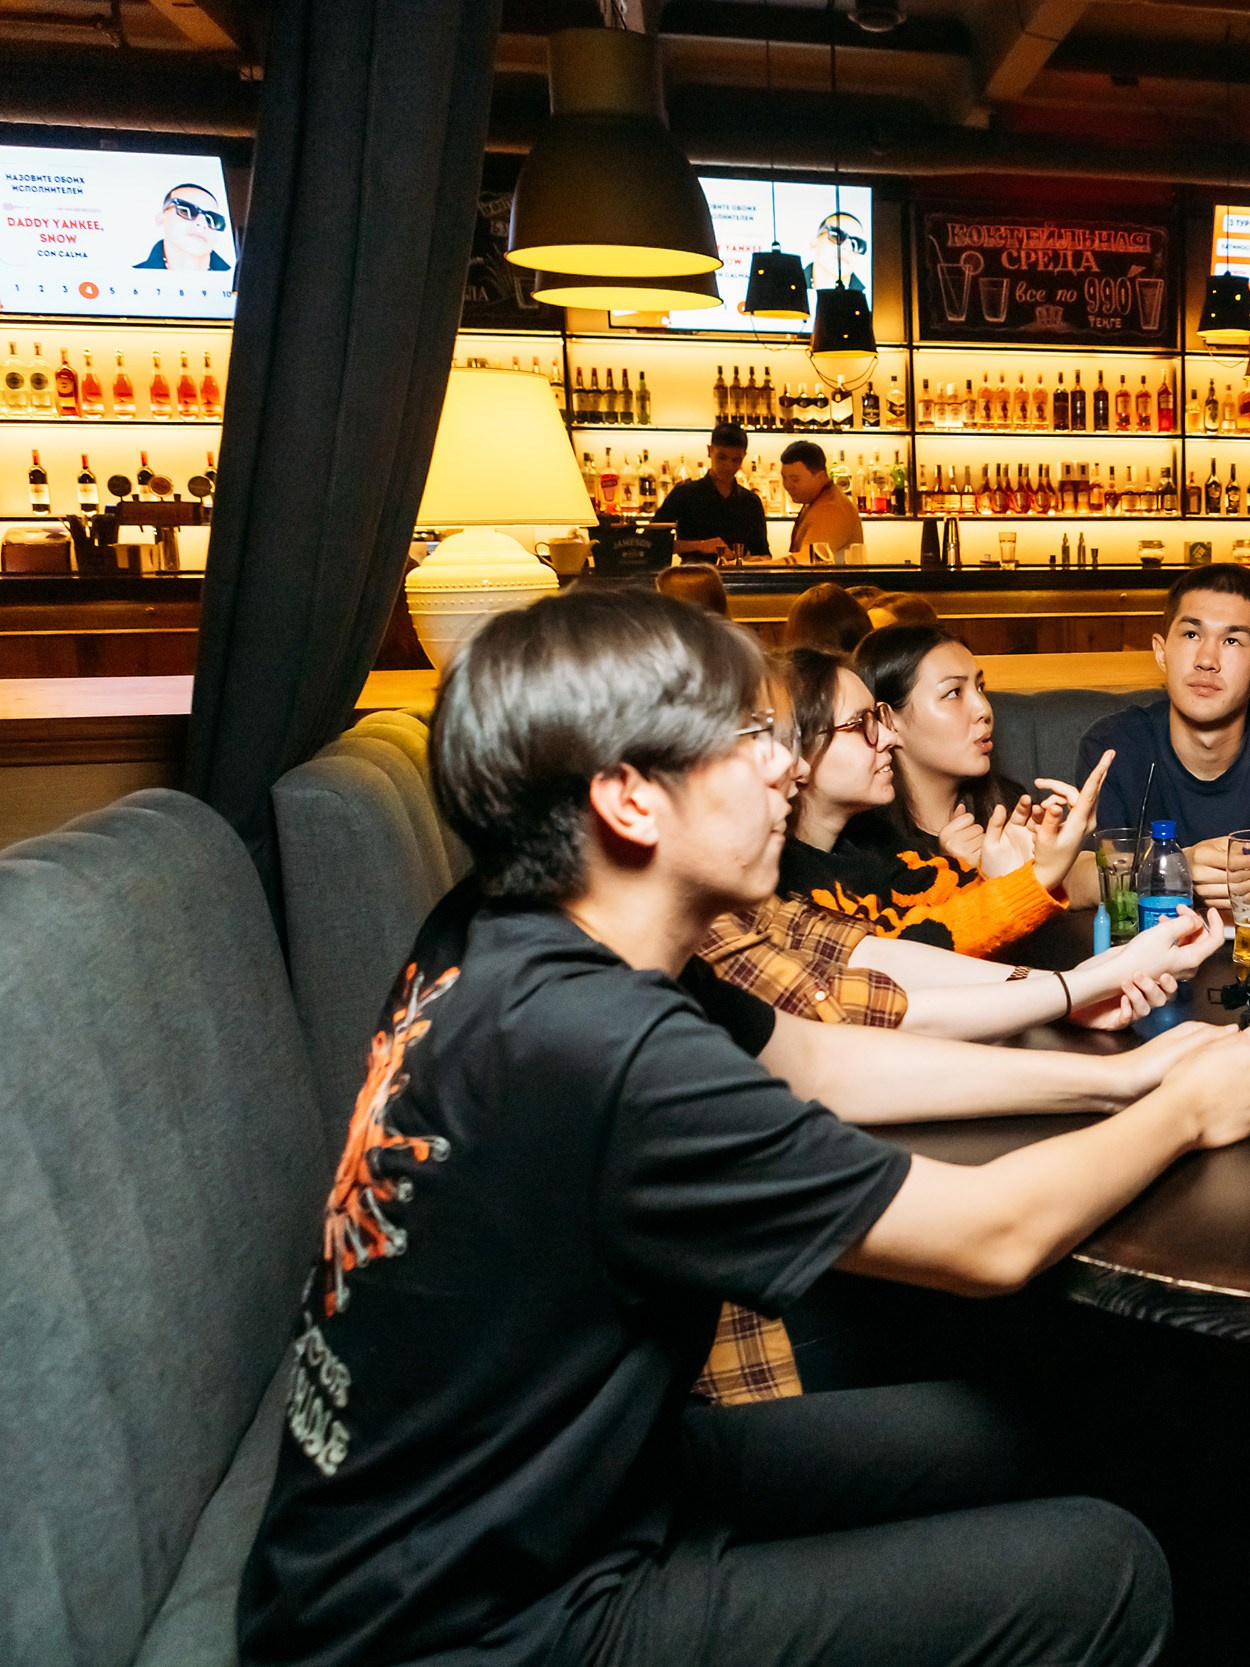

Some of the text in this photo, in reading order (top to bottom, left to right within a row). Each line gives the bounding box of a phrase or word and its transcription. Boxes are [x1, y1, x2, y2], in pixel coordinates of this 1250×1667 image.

[5, 173, 85, 184] НАЗОВИТЕ ОБОИХ
[12, 185, 84, 195] ИСПОЛНИТЕЛЕЙ
[7, 217, 104, 232] DADDY YANKEE,
[40, 233, 77, 244] SNOW
[947, 221, 1151, 254] КОКТЕЙЛЬНАЯ
[37, 249, 88, 258] CON CALMA
[1001, 249, 1100, 276] СРЕДА
[222, 290, 232, 299] 10
[1015, 276, 1132, 315] все по 990
